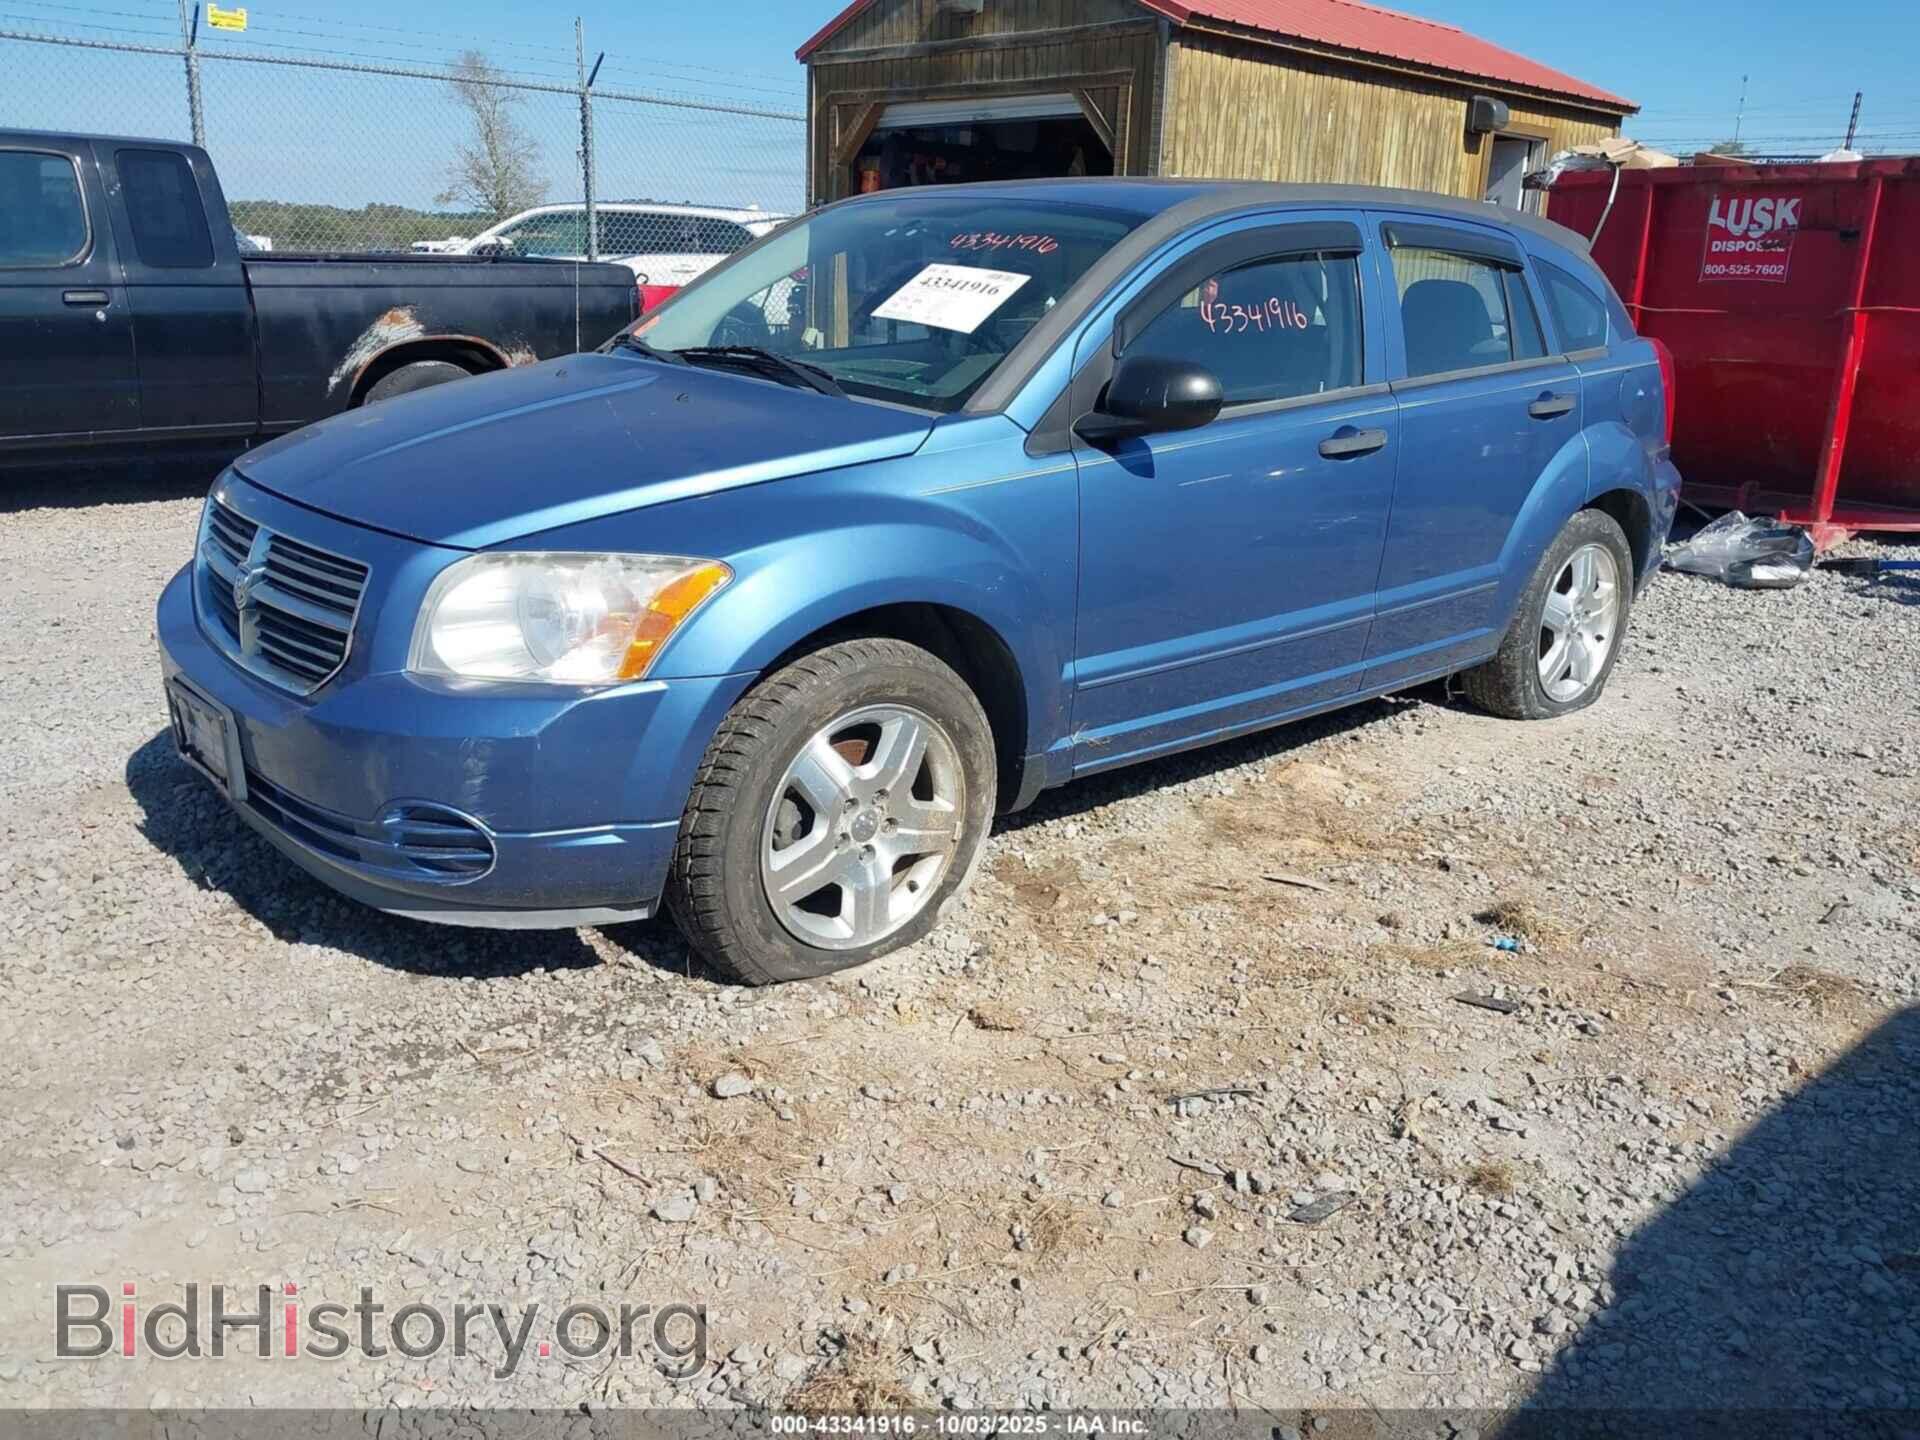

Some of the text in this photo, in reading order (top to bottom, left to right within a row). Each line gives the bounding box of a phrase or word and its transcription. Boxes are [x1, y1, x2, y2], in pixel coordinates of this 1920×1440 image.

[1709, 197, 1801, 238] LUSK
[950, 233, 1058, 253] 43341916
[1704, 264, 1785, 275] 800-525-7602
[920, 276, 1000, 295] 43341916
[1201, 297, 1308, 333] 43341916
